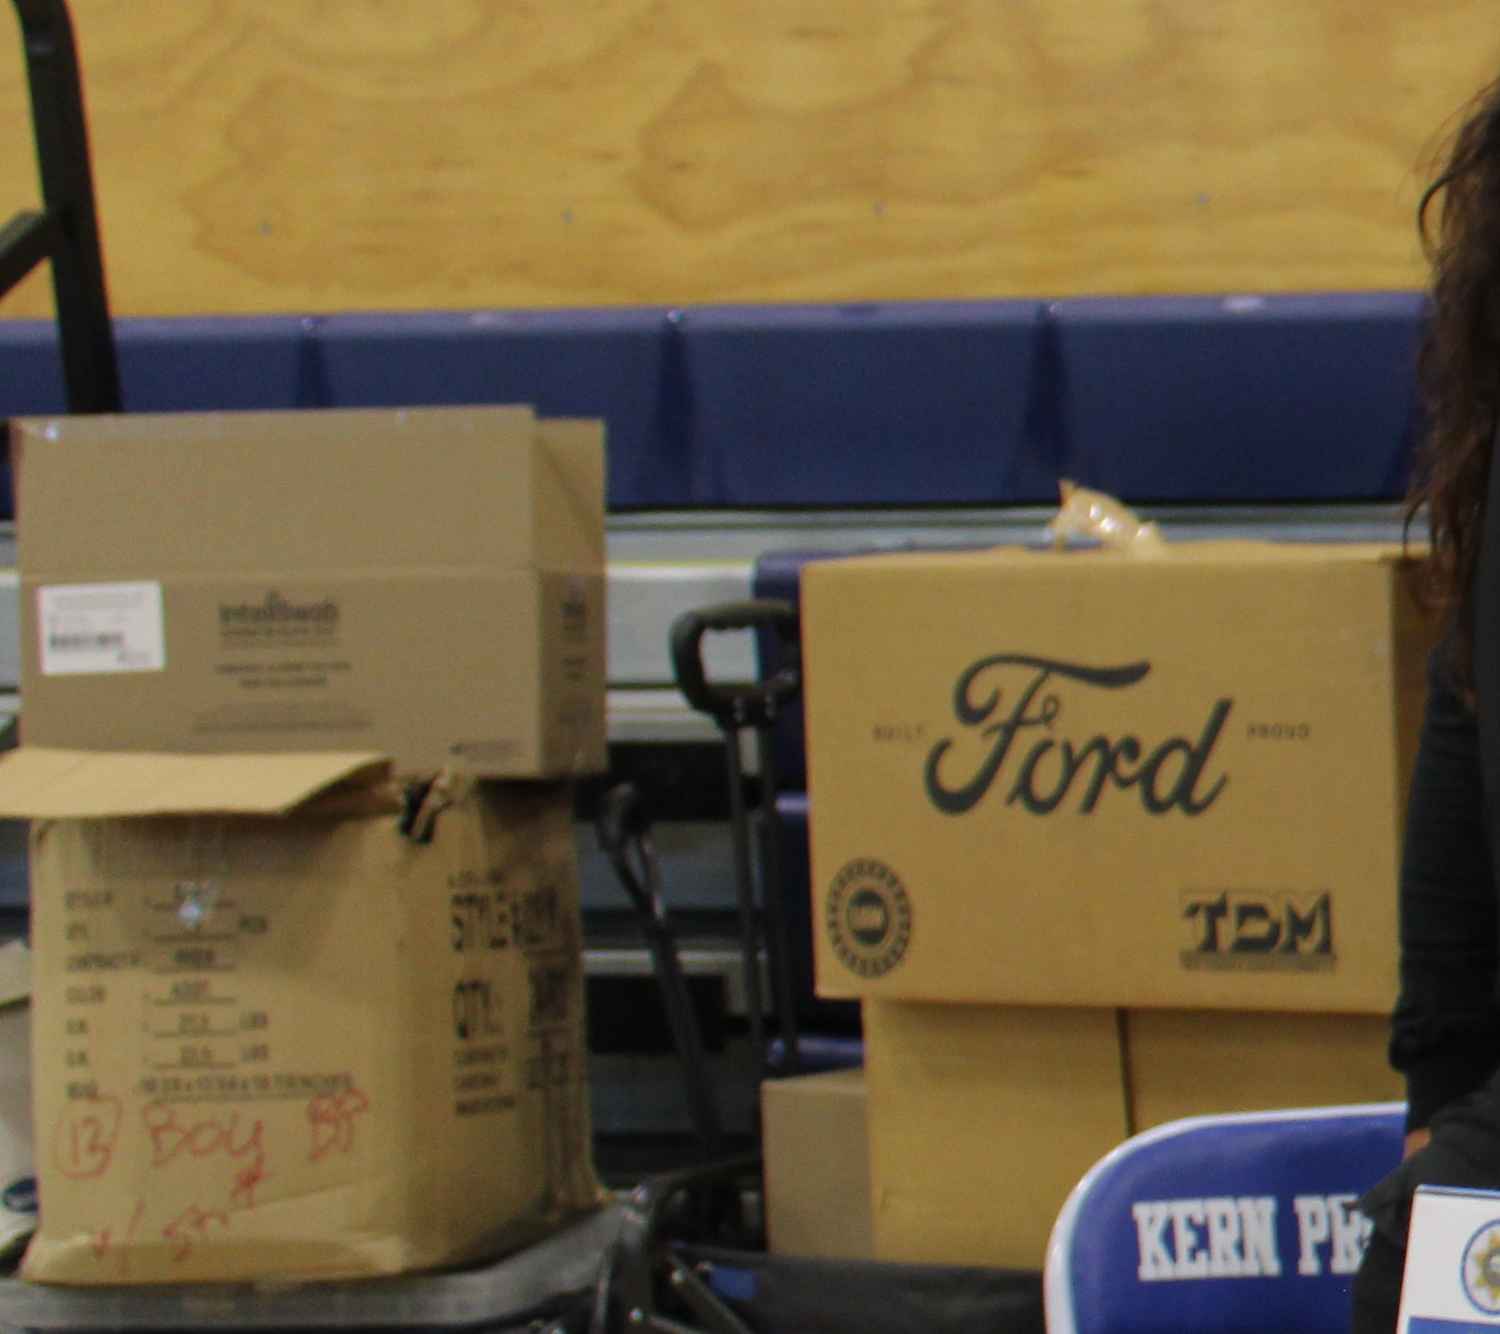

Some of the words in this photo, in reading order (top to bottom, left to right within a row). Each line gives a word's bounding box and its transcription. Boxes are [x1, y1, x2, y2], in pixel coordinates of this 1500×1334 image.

[924, 652, 1234, 817] Ford
[1246, 722, 1312, 742] PROUD
[1131, 1197, 1281, 1282] KERN
